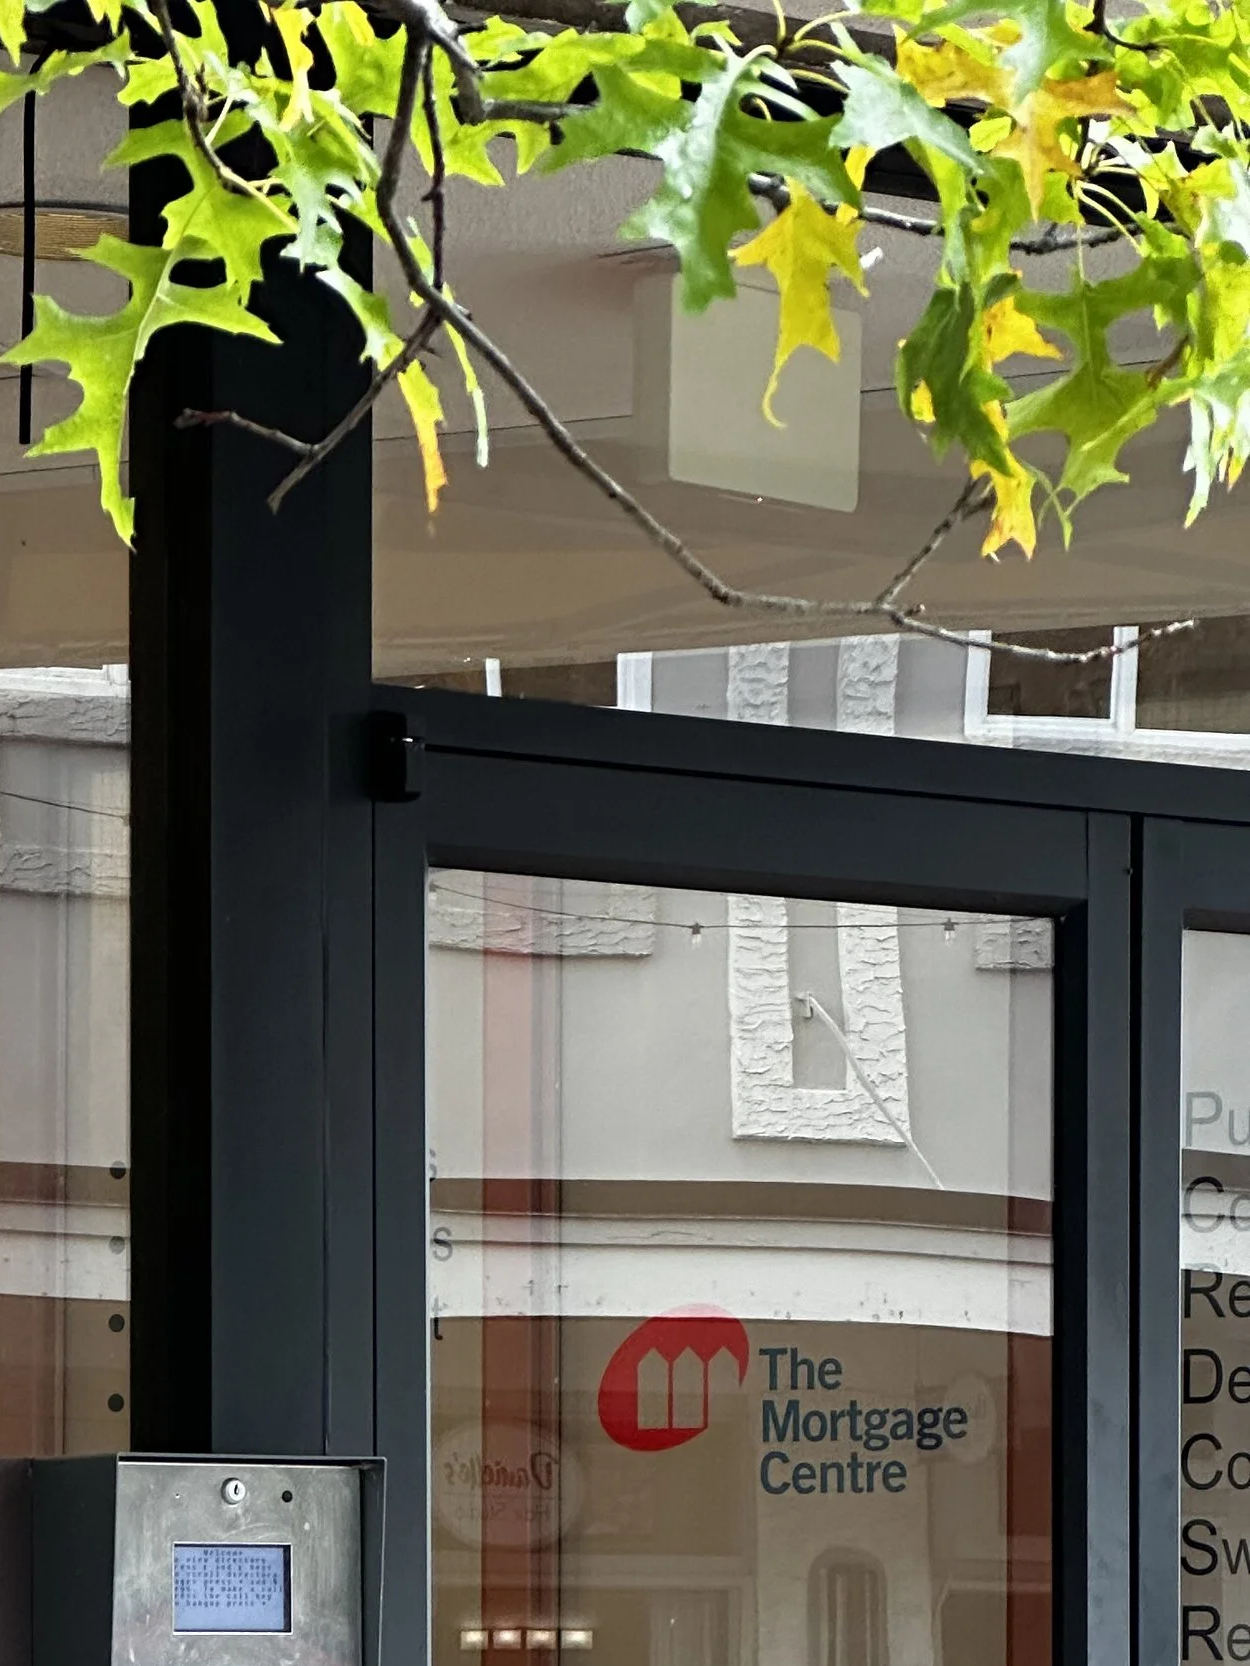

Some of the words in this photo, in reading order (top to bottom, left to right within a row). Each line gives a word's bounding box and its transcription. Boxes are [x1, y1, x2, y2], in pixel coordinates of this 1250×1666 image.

[759, 1347, 843, 1390] The
[762, 1399, 968, 1451] Mortgage
[760, 1450, 907, 1495] Centre
